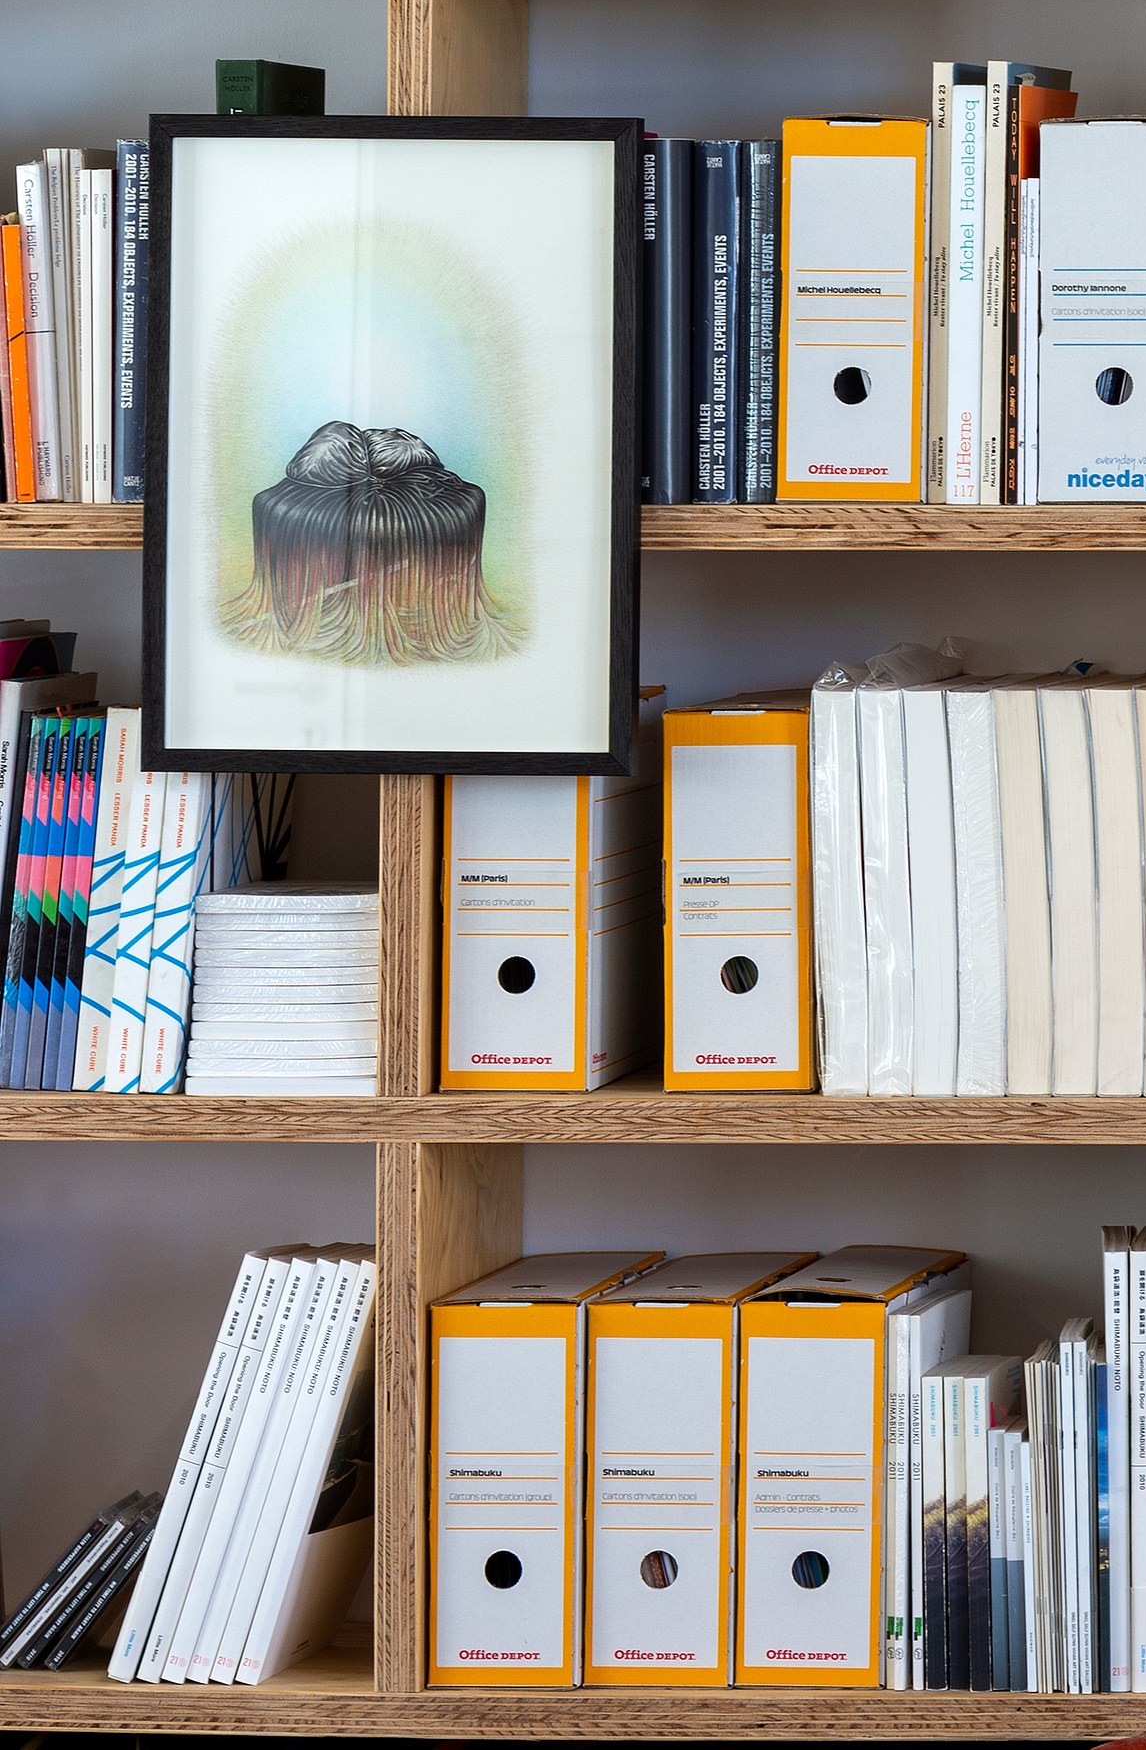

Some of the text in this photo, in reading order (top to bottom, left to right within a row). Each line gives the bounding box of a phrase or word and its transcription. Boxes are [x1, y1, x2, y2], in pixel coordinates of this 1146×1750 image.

[959, 99, 980, 282] Michel Houellebecq
[643, 154, 658, 241] CARSTEN HÖLLER
[124, 220, 135, 240] 184
[122, 241, 136, 291] OBJECTS,
[798, 286, 882, 295] Michel Houellebecq
[1052, 284, 1127, 293] Dorothy Iannone
[120, 292, 135, 368] EXPERIMENTS,
[120, 370, 133, 409] EVENTS
[956, 411, 972, 480] L'Herne
[808, 464, 888, 475] Office DEPOT
[953, 484, 974, 498] 117
[481, 874, 508, 883] (Paris)
[683, 876, 730, 885] M/M (Paris)
[471, 1053, 552, 1065] Office DEPOT
[696, 1054, 777, 1065] Office DEPOT
[449, 1469, 502, 1477] Shimabuku
[602, 1468, 655, 1476] Shimabuku
[459, 1650, 499, 1660] Office
[614, 1650, 654, 1660] Office
[766, 1650, 806, 1660] Office
